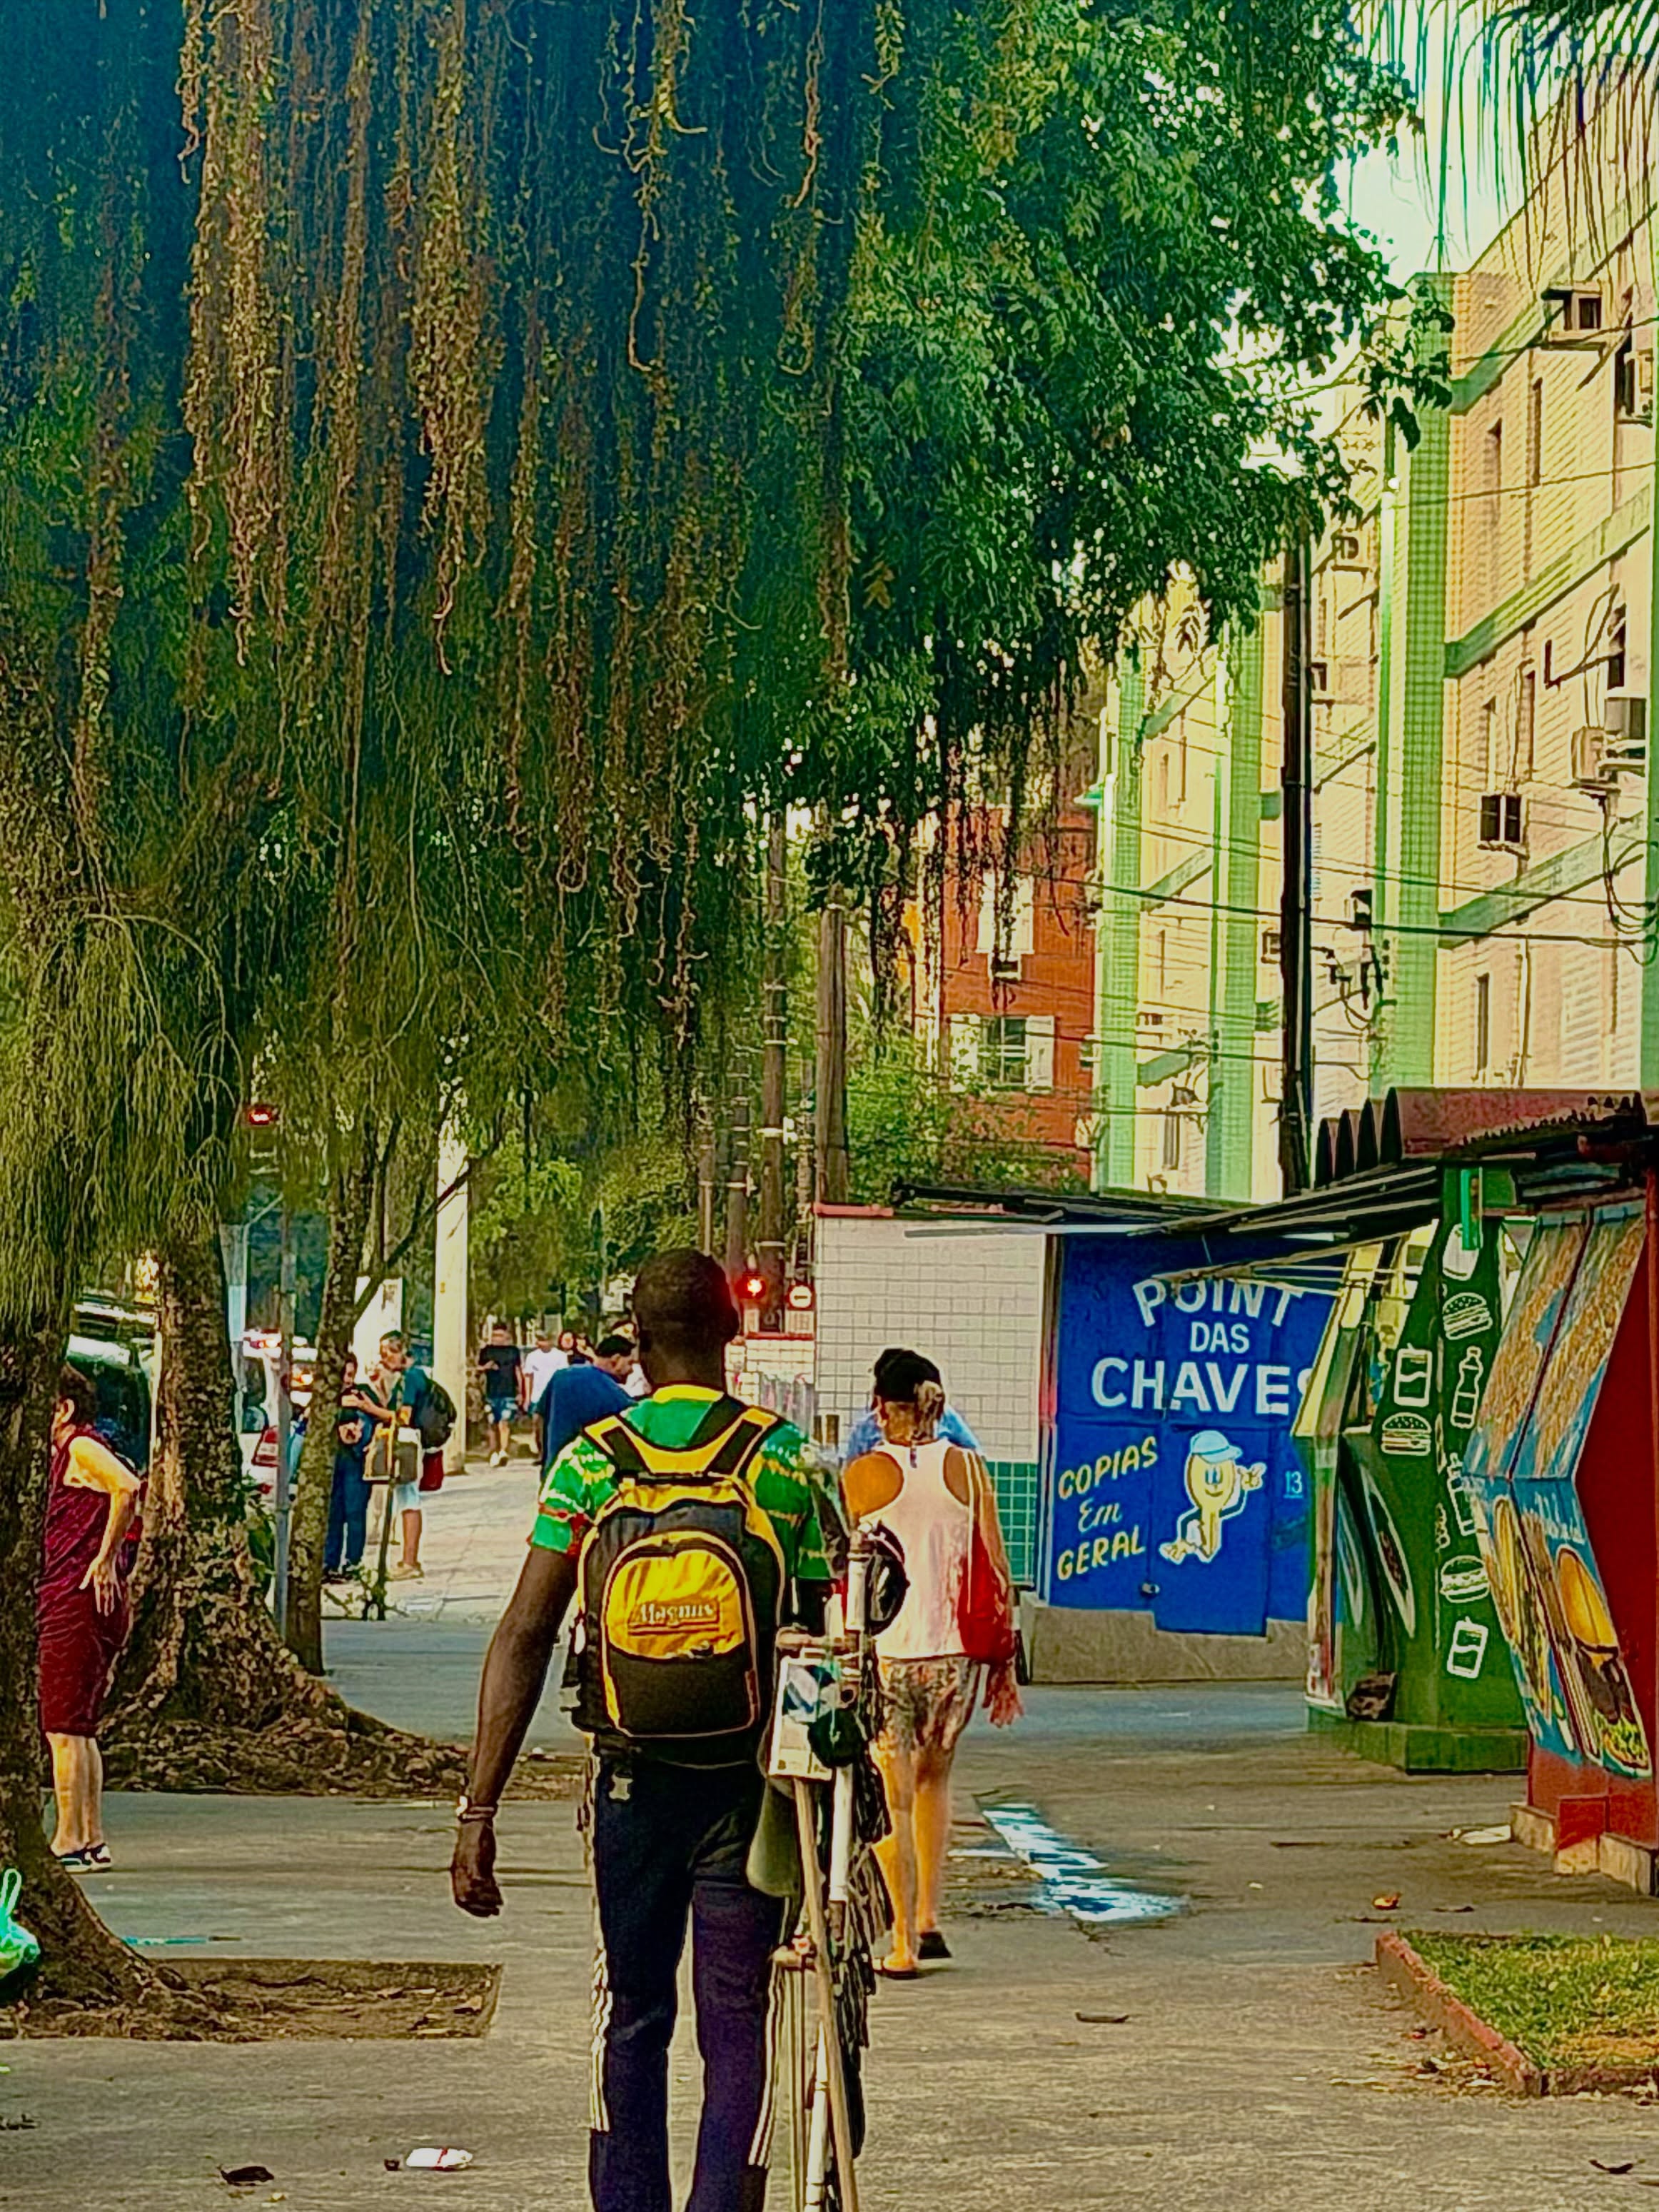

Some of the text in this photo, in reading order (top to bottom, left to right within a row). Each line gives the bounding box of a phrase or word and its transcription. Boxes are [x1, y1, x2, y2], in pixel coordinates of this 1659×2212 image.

[1132, 1277, 1302, 1327] POINT
[1189, 1321, 1249, 1354] DAS
[1058, 1436, 1158, 1499] COPIAS
[1286, 1471, 1303, 1494] 13
[1078, 1497, 1122, 1533] Em
[1057, 1524, 1146, 1580] GERAL
